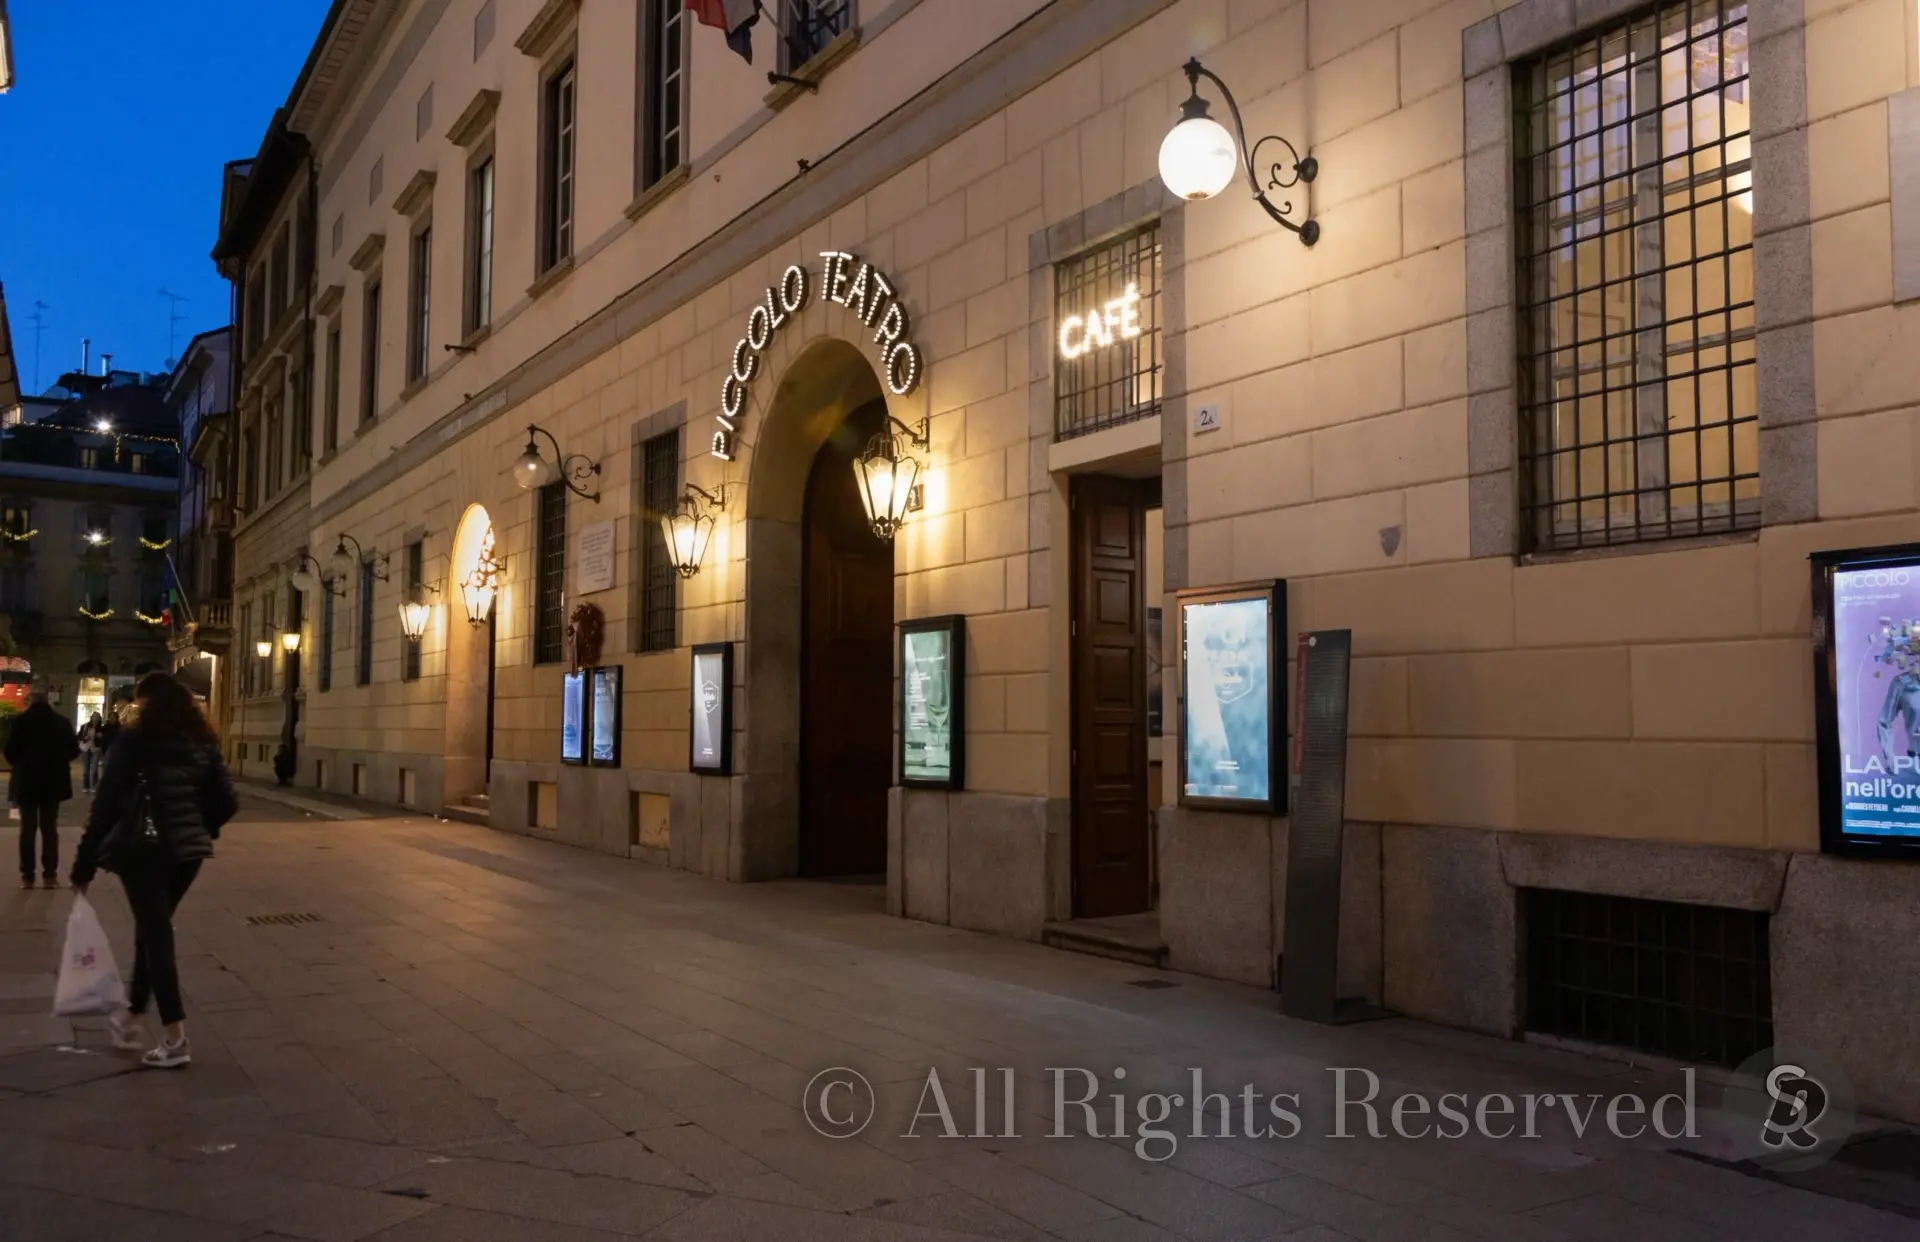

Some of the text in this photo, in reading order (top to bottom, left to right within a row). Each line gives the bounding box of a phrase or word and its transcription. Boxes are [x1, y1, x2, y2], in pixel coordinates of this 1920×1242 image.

[1058, 283, 1141, 360] CAFÉ
[711, 251, 919, 461] PICCOLO TEATRO
[1839, 570, 1910, 589] PICCOLO
[1845, 754, 1887, 775] LA
